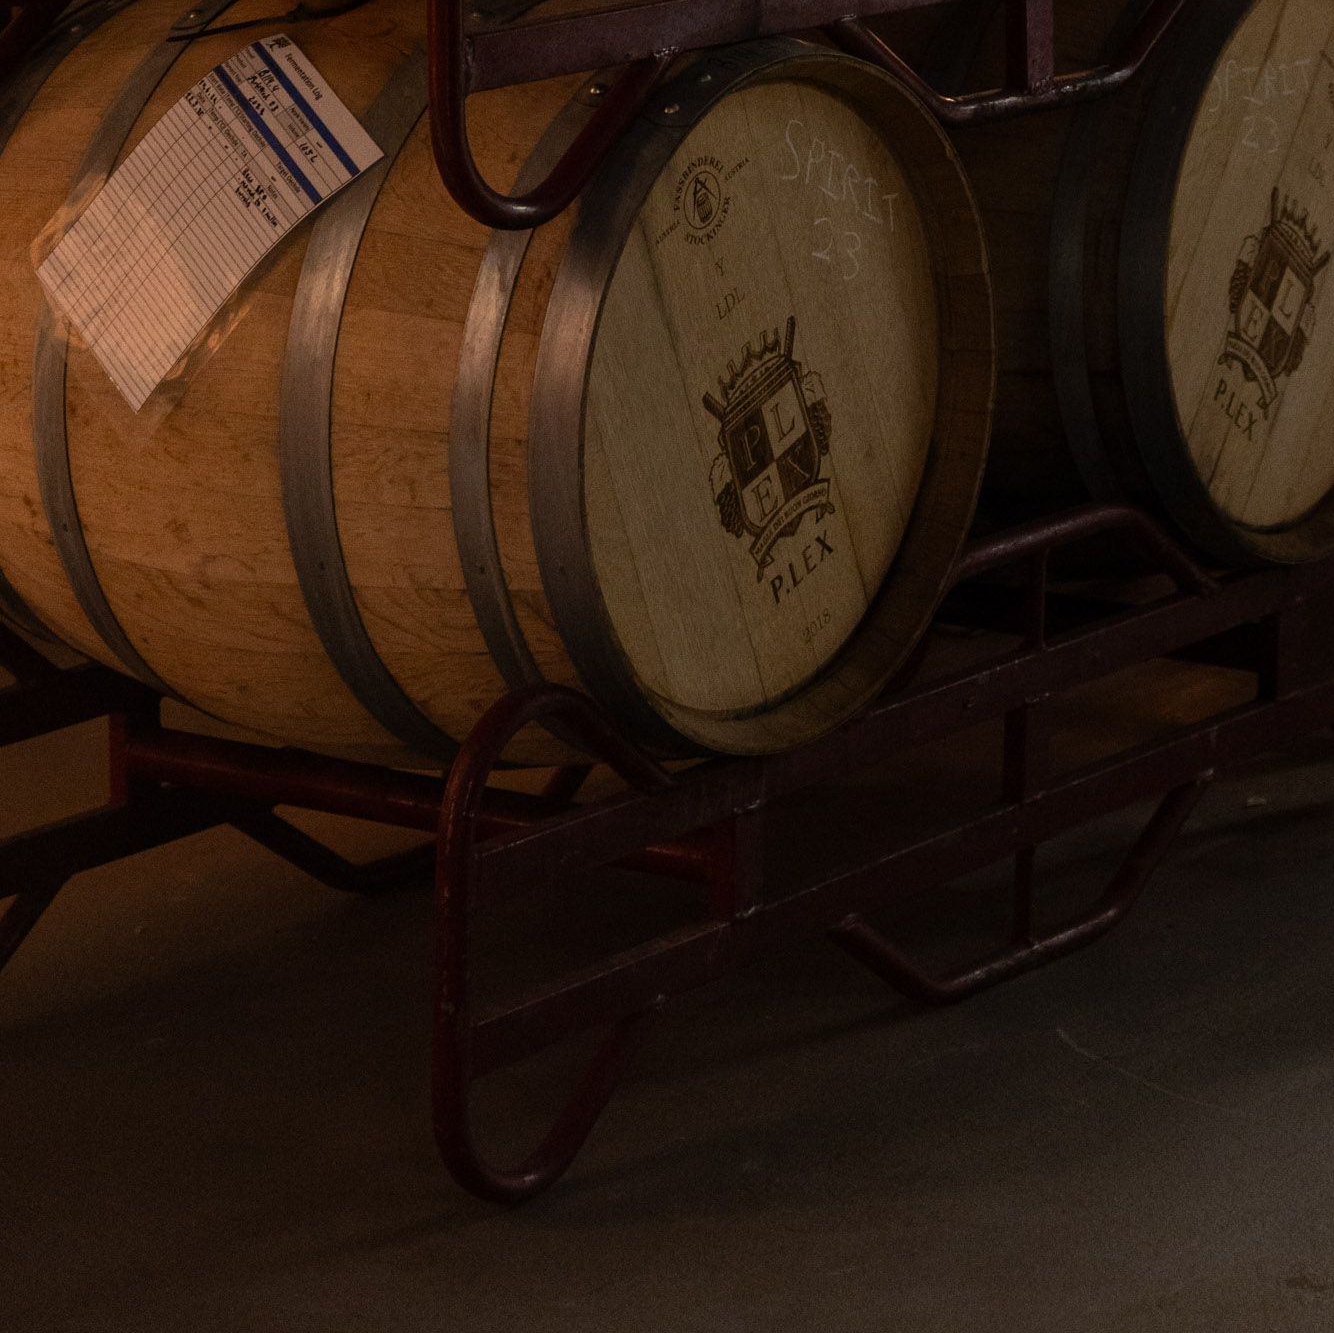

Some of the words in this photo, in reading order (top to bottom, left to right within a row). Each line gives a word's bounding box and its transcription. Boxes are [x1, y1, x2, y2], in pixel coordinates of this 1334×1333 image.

[283, 52, 316, 90] Fermentation
[310, 87, 323, 101] Log
[265, 183, 279, 200] Notes
[274, 161, 289, 178] Target
[673, 156, 723, 212] FASSBINDEREI
[724, 157, 750, 181] AUSTRIA
[781, 119, 900, 233] SPIRIT
[684, 196, 731, 246] STOCKINGER
[715, 256, 727, 277] Y
[811, 217, 862, 281] 23
[714, 285, 746, 321] LDL
[770, 529, 833, 604] P.LEX
